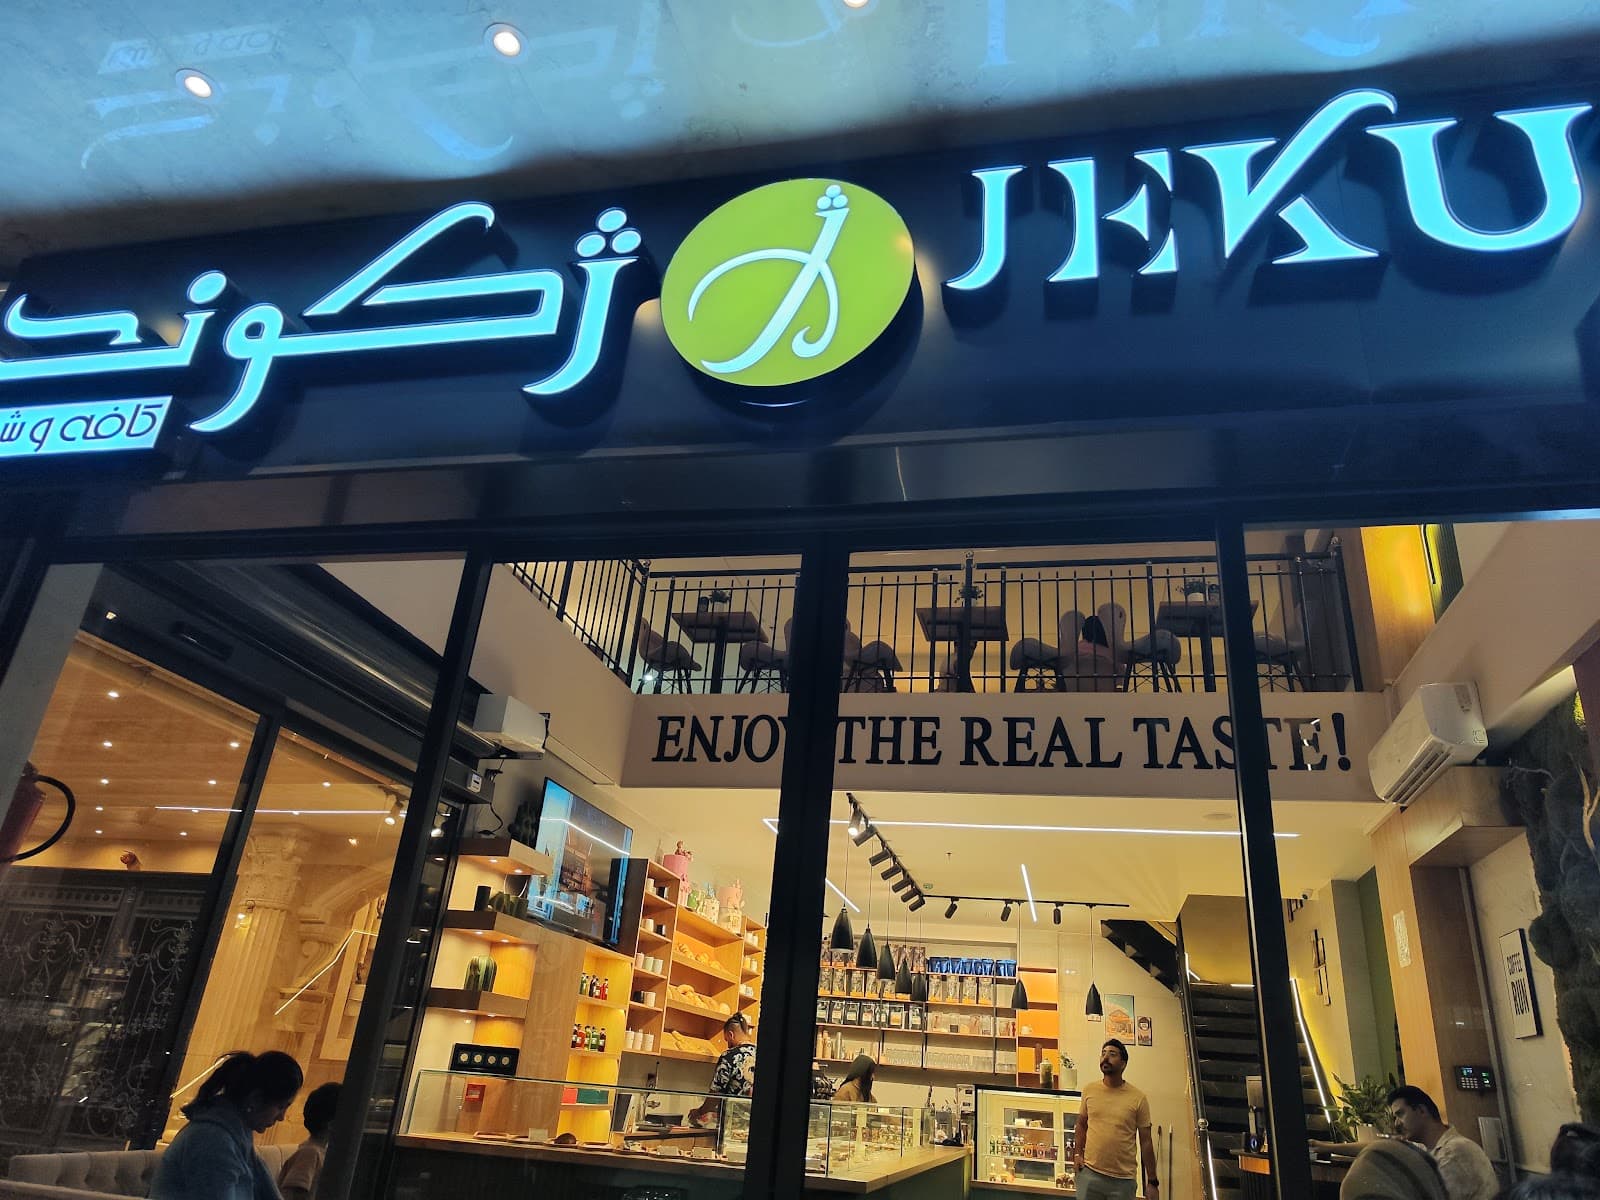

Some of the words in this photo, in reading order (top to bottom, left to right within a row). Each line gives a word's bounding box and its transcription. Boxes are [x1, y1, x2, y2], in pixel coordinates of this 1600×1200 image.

[652, 714, 788, 763] ENJO
[837, 715, 943, 765] THE
[959, 715, 1122, 768] REAL
[1506, 952, 1523, 975] COFFEE
[1511, 978, 1530, 1016] RUN
